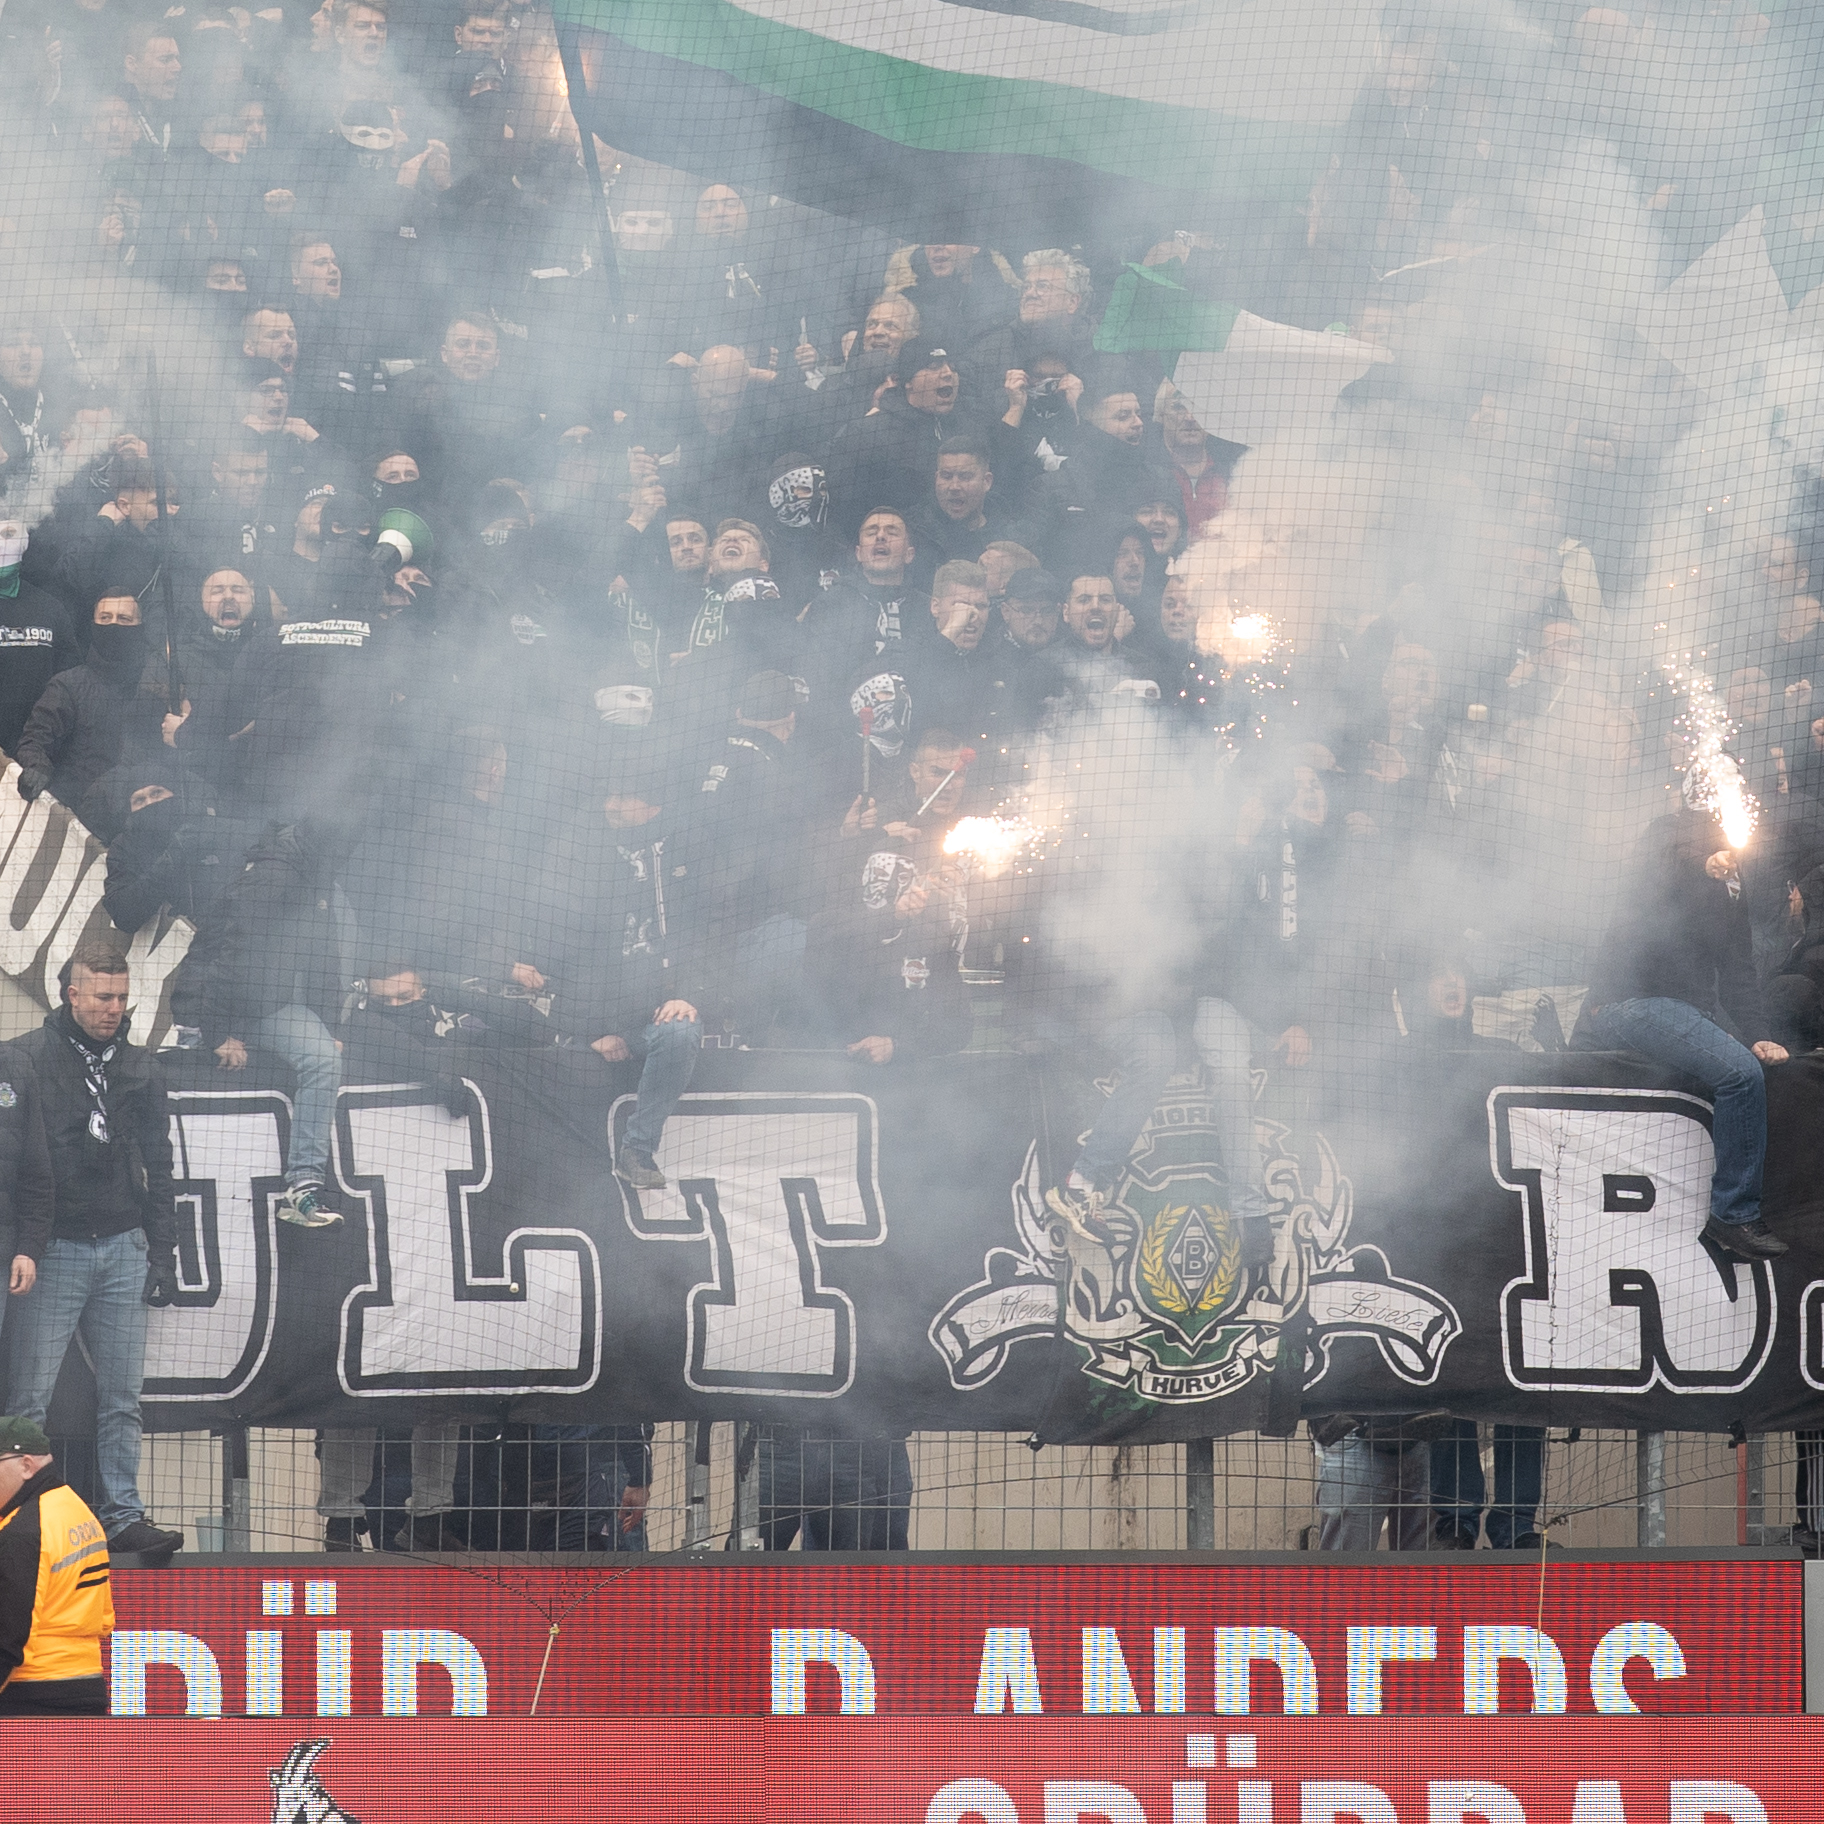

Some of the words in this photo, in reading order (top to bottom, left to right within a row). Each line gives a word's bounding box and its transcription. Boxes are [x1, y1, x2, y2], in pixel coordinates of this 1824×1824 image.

[24, 625, 54, 643] 1900
[278, 618, 371, 638] SOTTOCULTURA
[281, 633, 363, 648] ASCENDENTE
[1150, 1361, 1241, 1396] KURVE
